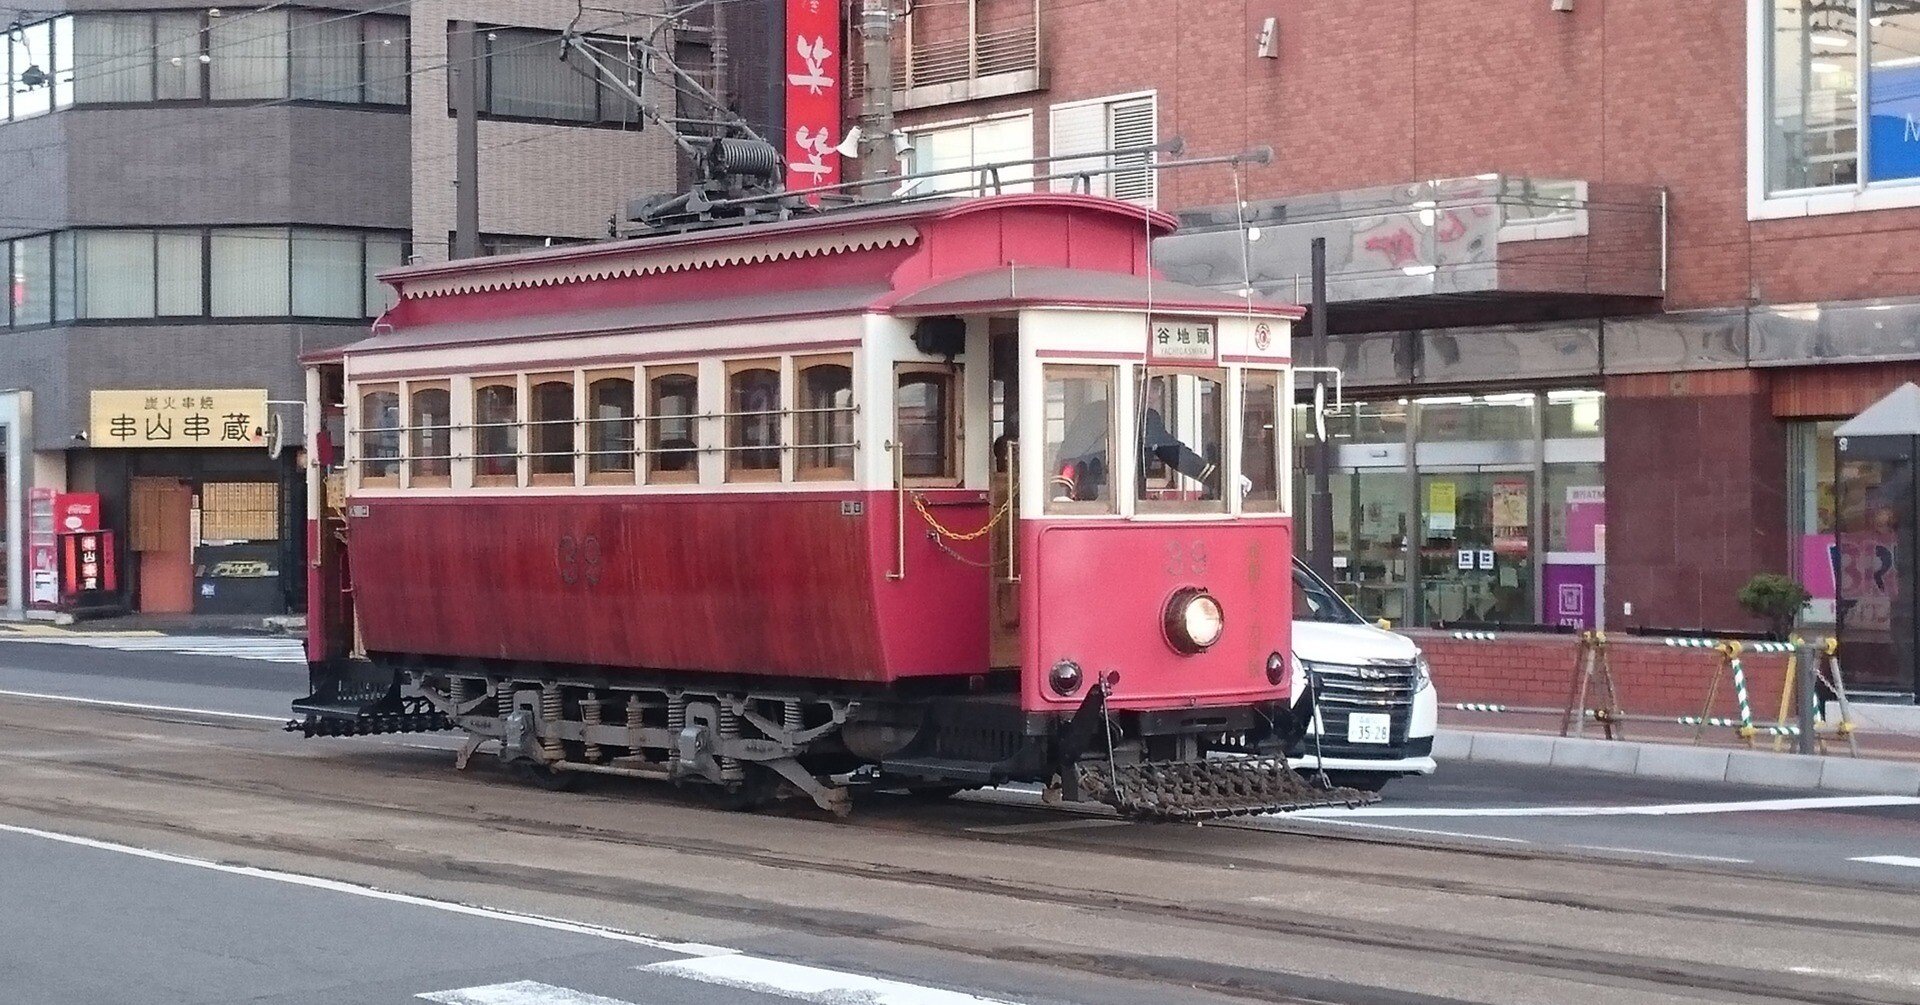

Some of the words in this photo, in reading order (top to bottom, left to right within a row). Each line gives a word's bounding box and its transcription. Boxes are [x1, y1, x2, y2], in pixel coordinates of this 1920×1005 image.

[1158, 327, 1209, 344] 谷地頭
[145, 396, 213, 410] 炭火串焼
[110, 413, 250, 441] 串山串蔵
[1560, 618, 1584, 630] ATM
